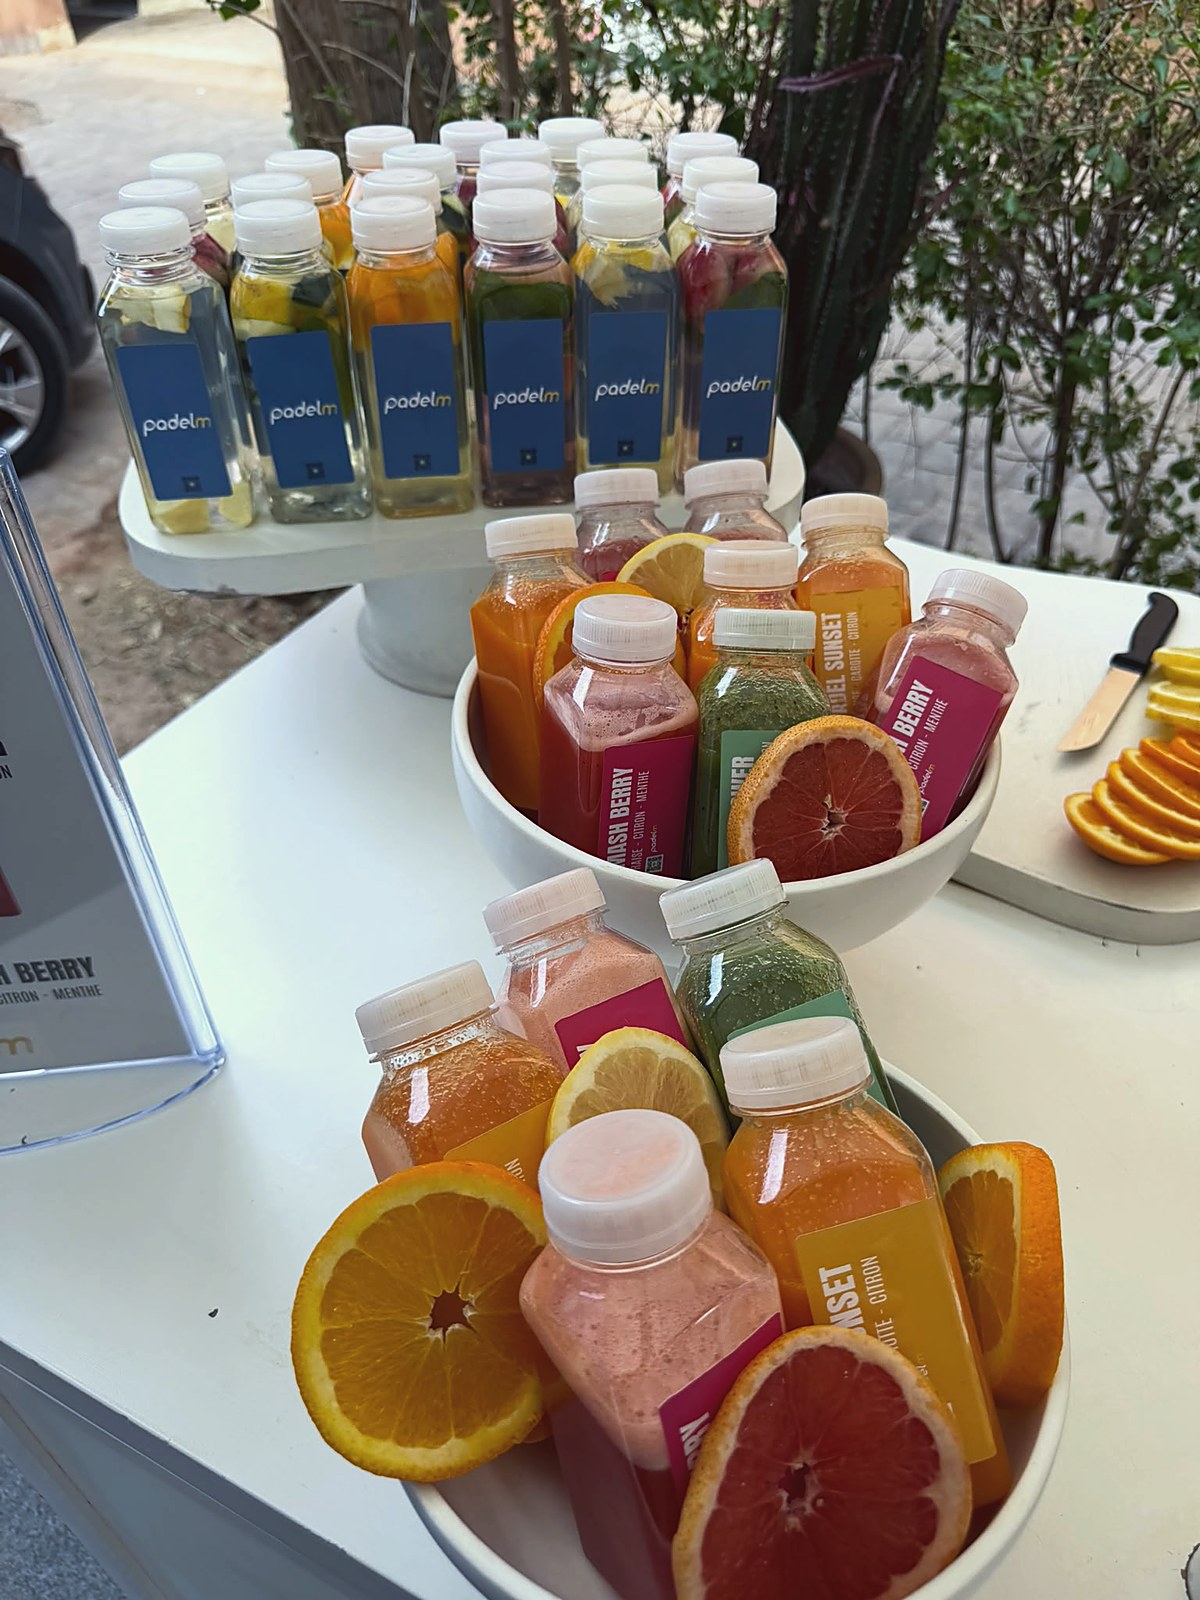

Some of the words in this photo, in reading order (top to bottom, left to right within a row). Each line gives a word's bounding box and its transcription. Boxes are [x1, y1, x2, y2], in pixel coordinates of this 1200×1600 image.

[493, 387, 560, 410] padelm
[594, 378, 660, 401] padelm
[706, 375, 771, 399] padelm
[270, 401, 338, 425] padelm
[384, 391, 451, 414] padelm
[143, 413, 211, 436] padelm
[846, 611, 860, 640] CITRON
[820, 613, 845, 671] SUNSET
[826, 675, 848, 714] ADEL
[892, 679, 934, 737] BERRY
[908, 738, 929, 771] CITRON
[923, 698, 948, 733] MENTHE
[609, 768, 634, 820] BERRY
[636, 770, 650, 803] MENTHE
[633, 811, 646, 840] CITRON
[649, 825, 658, 853] padelm
[607, 821, 629, 867] MASH
[631, 847, 643, 870] RAISE
[13, 956, 95, 984] BERRY
[52, 984, 103, 1000] MENTHE
[860, 1255, 887, 1305] CITRON
